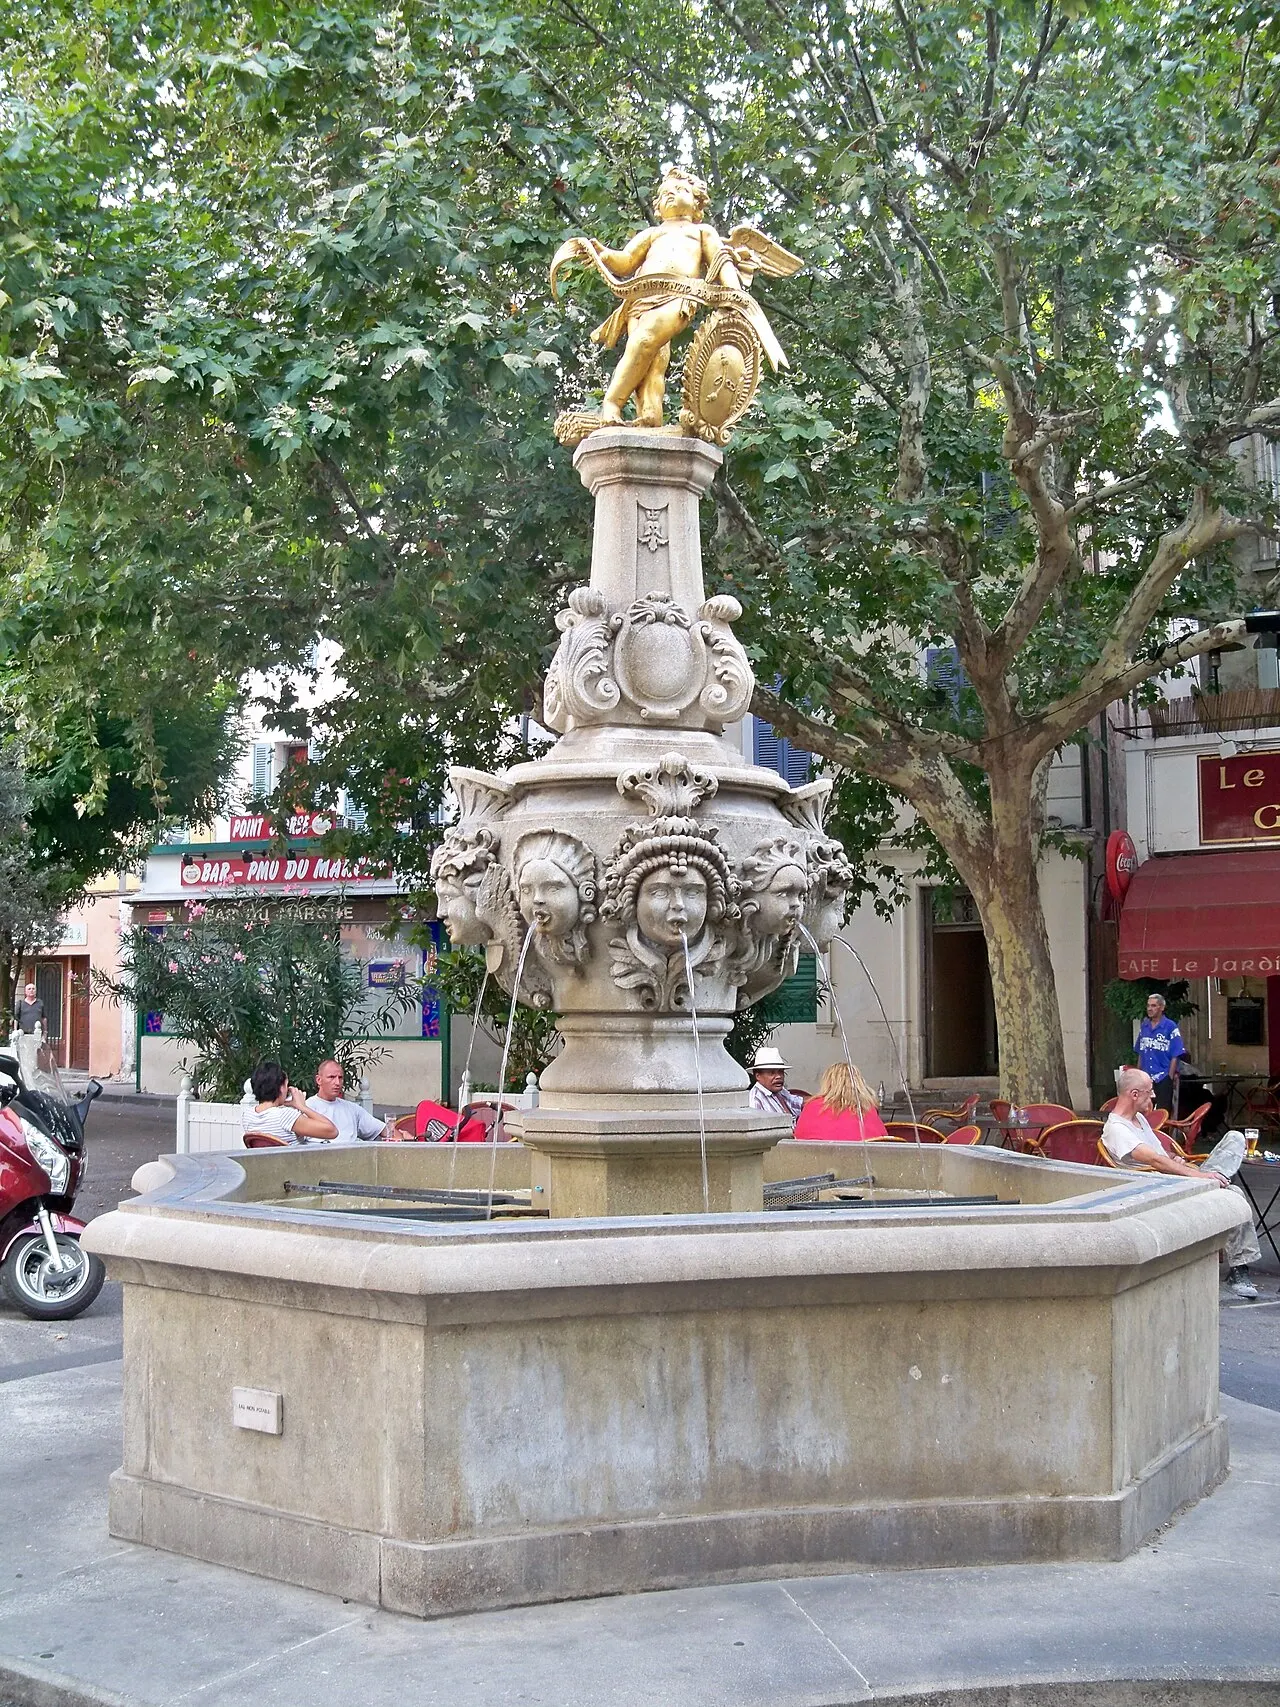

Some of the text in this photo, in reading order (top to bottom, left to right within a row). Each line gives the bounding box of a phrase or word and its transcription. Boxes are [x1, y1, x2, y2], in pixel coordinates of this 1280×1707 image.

[1219, 766, 1266, 790] Le
[232, 817, 264, 838] POINT
[201, 862, 230, 883] BAR
[247, 860, 280, 881] PMU
[284, 859, 310, 880] DU
[1119, 959, 1159, 974] CAFE
[1173, 958, 1198, 972] Le
